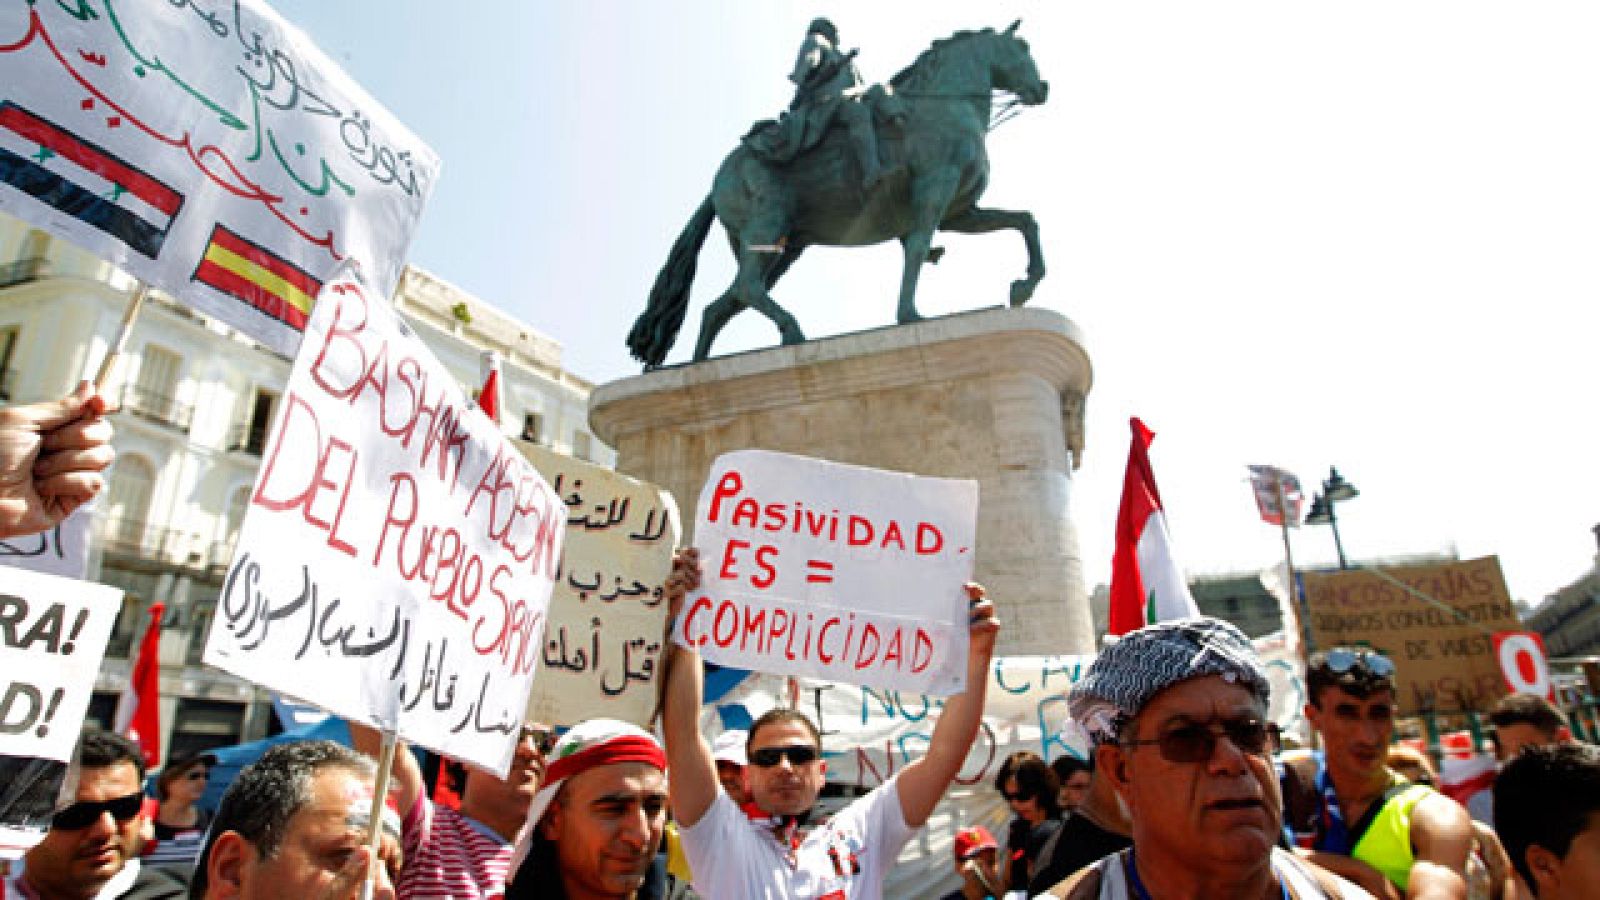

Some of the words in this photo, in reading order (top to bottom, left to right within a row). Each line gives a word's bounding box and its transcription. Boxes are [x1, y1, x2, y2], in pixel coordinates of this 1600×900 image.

[251, 391, 359, 558] DEL
[373, 471, 485, 621] PUEBLO
[629, 509, 669, 541] لا
[568, 571, 664, 606] وحزب
[719, 539, 781, 589] ES
[806, 559, 834, 583] =
[602, 637, 660, 696] قتل
